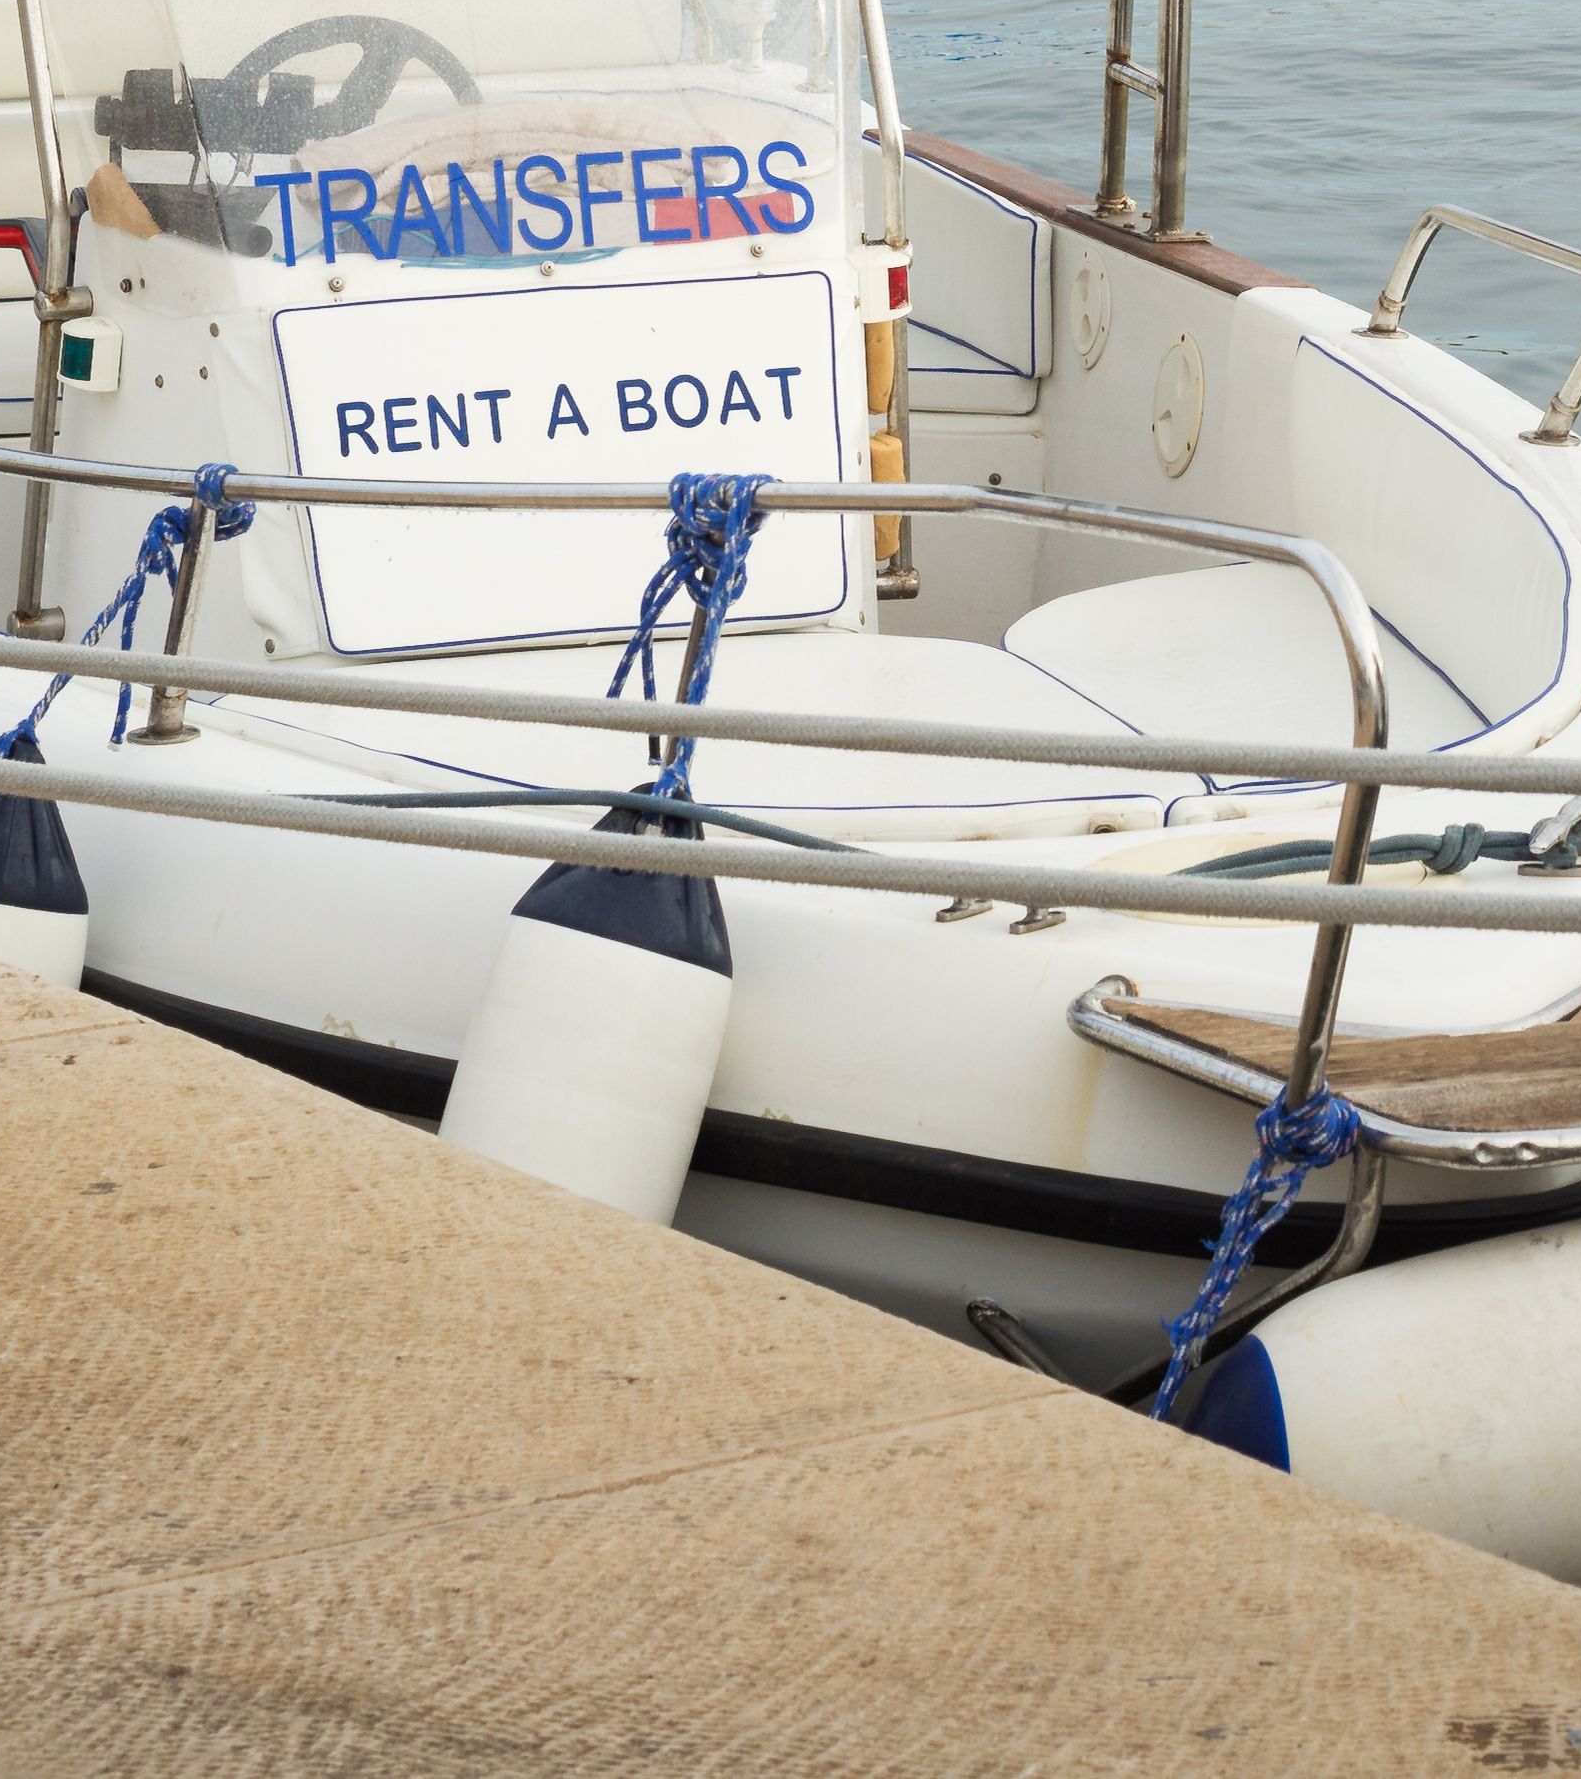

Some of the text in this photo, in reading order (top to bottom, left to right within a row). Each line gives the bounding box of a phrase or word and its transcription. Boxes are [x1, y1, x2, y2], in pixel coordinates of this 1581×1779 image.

[253, 140, 815, 268] TRANSFERS
[336, 366, 802, 457] RENT A BOAT
